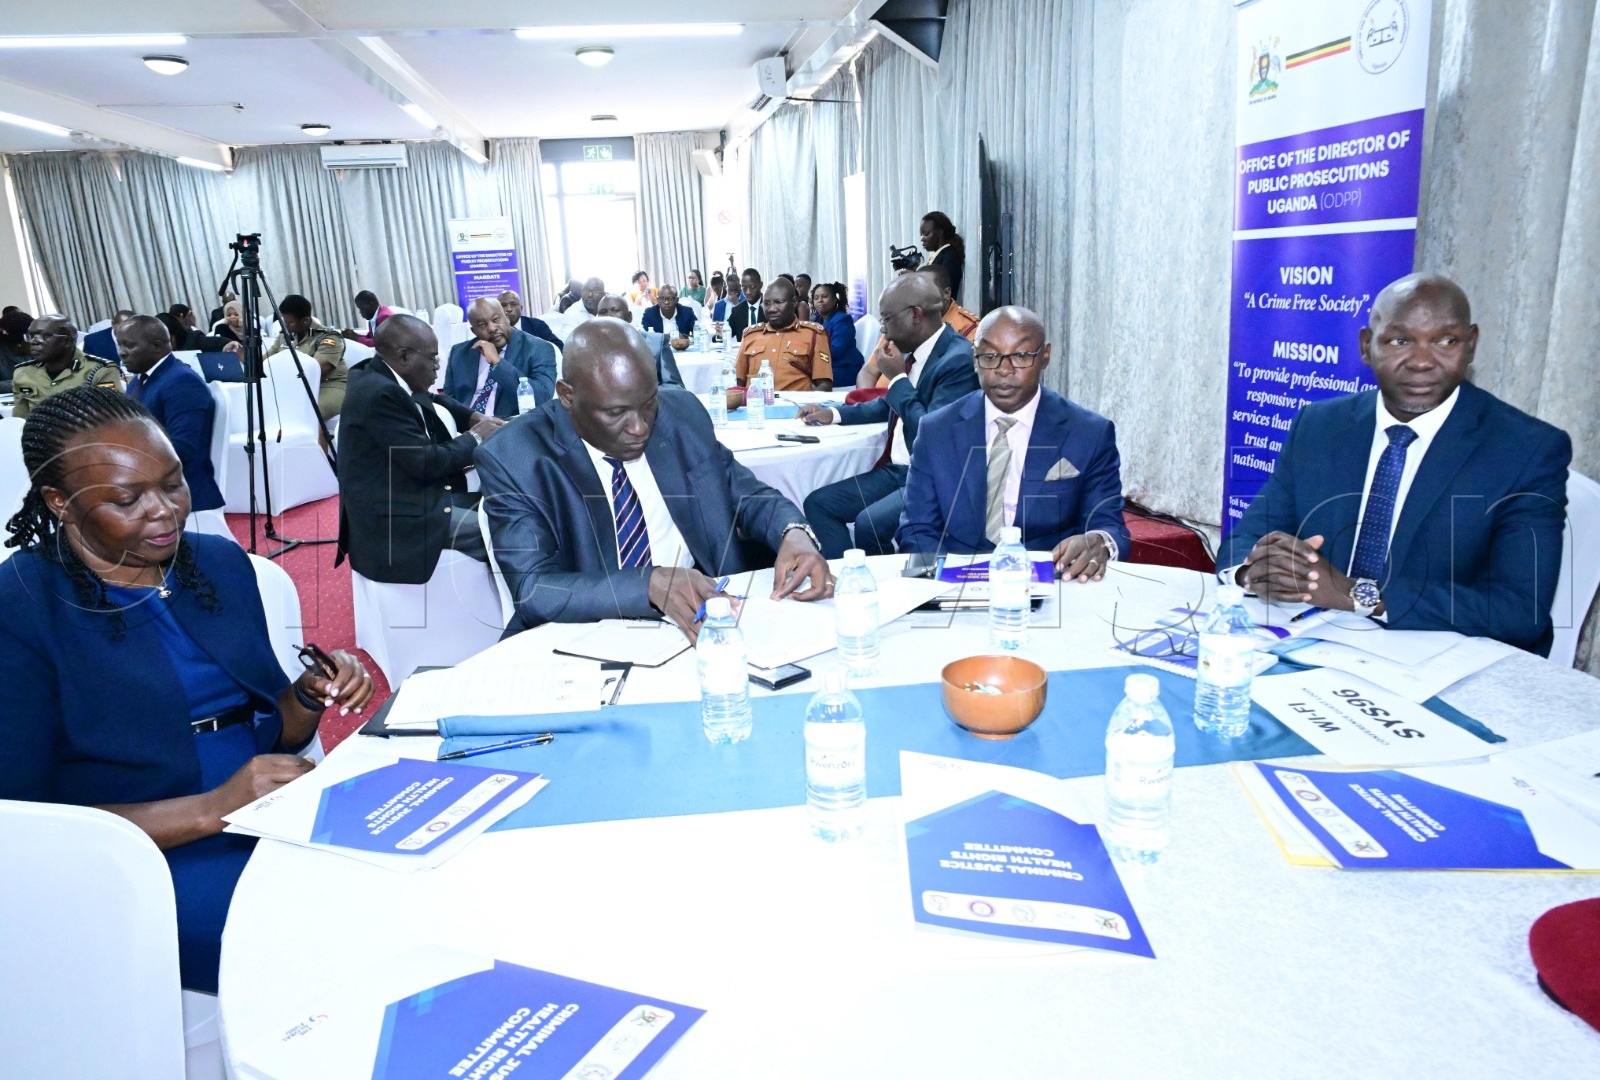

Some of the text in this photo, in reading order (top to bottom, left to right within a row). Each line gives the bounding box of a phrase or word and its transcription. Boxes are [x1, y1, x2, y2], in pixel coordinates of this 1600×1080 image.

[1239, 130, 1411, 174] OFFICE OF THE DIRECTOR OF
[1248, 160, 1390, 194] PUBLIC PROSECUTIONS
[1267, 188, 1362, 214] UGANDA (ODPP)
[1280, 266, 1333, 285] VISION
[1258, 293, 1291, 310] Crime
[1292, 294, 1317, 311] Free
[1273, 340, 1339, 364] MISSION
[1251, 367, 1290, 383] provide
[1290, 370, 1360, 393] professional
[1246, 390, 1297, 409] responsive
[1232, 409, 1293, 431] services that
[1244, 432, 1283, 453] trust an
[1233, 453, 1276, 474] national
[1287, 702, 1342, 733] WI-FI
[1332, 689, 1426, 738] SYS96
[364, 781, 421, 820] COMMITTEE
[366, 778, 441, 828] HEALTH RIGHTS
[369, 776, 454, 835] CRIMINAL JUSTICE
[1348, 783, 1427, 843] CRIMINAL JUSTICE
[1390, 793, 1446, 831] COMMITTEE
[1397, 811, 1440, 838] HEALTH
[950, 851, 1073, 869] HEALTH RIGHTS
[963, 842, 1055, 857] COMMITTEE
[939, 859, 1084, 881] CRIMINAL JUSTICE
[503, 1002, 560, 1048] HEALTH
[514, 1003, 580, 1056] CRIMINAL
[448, 1007, 531, 1077] COMMITTEE
[462, 1047, 510, 1080] RIGH
